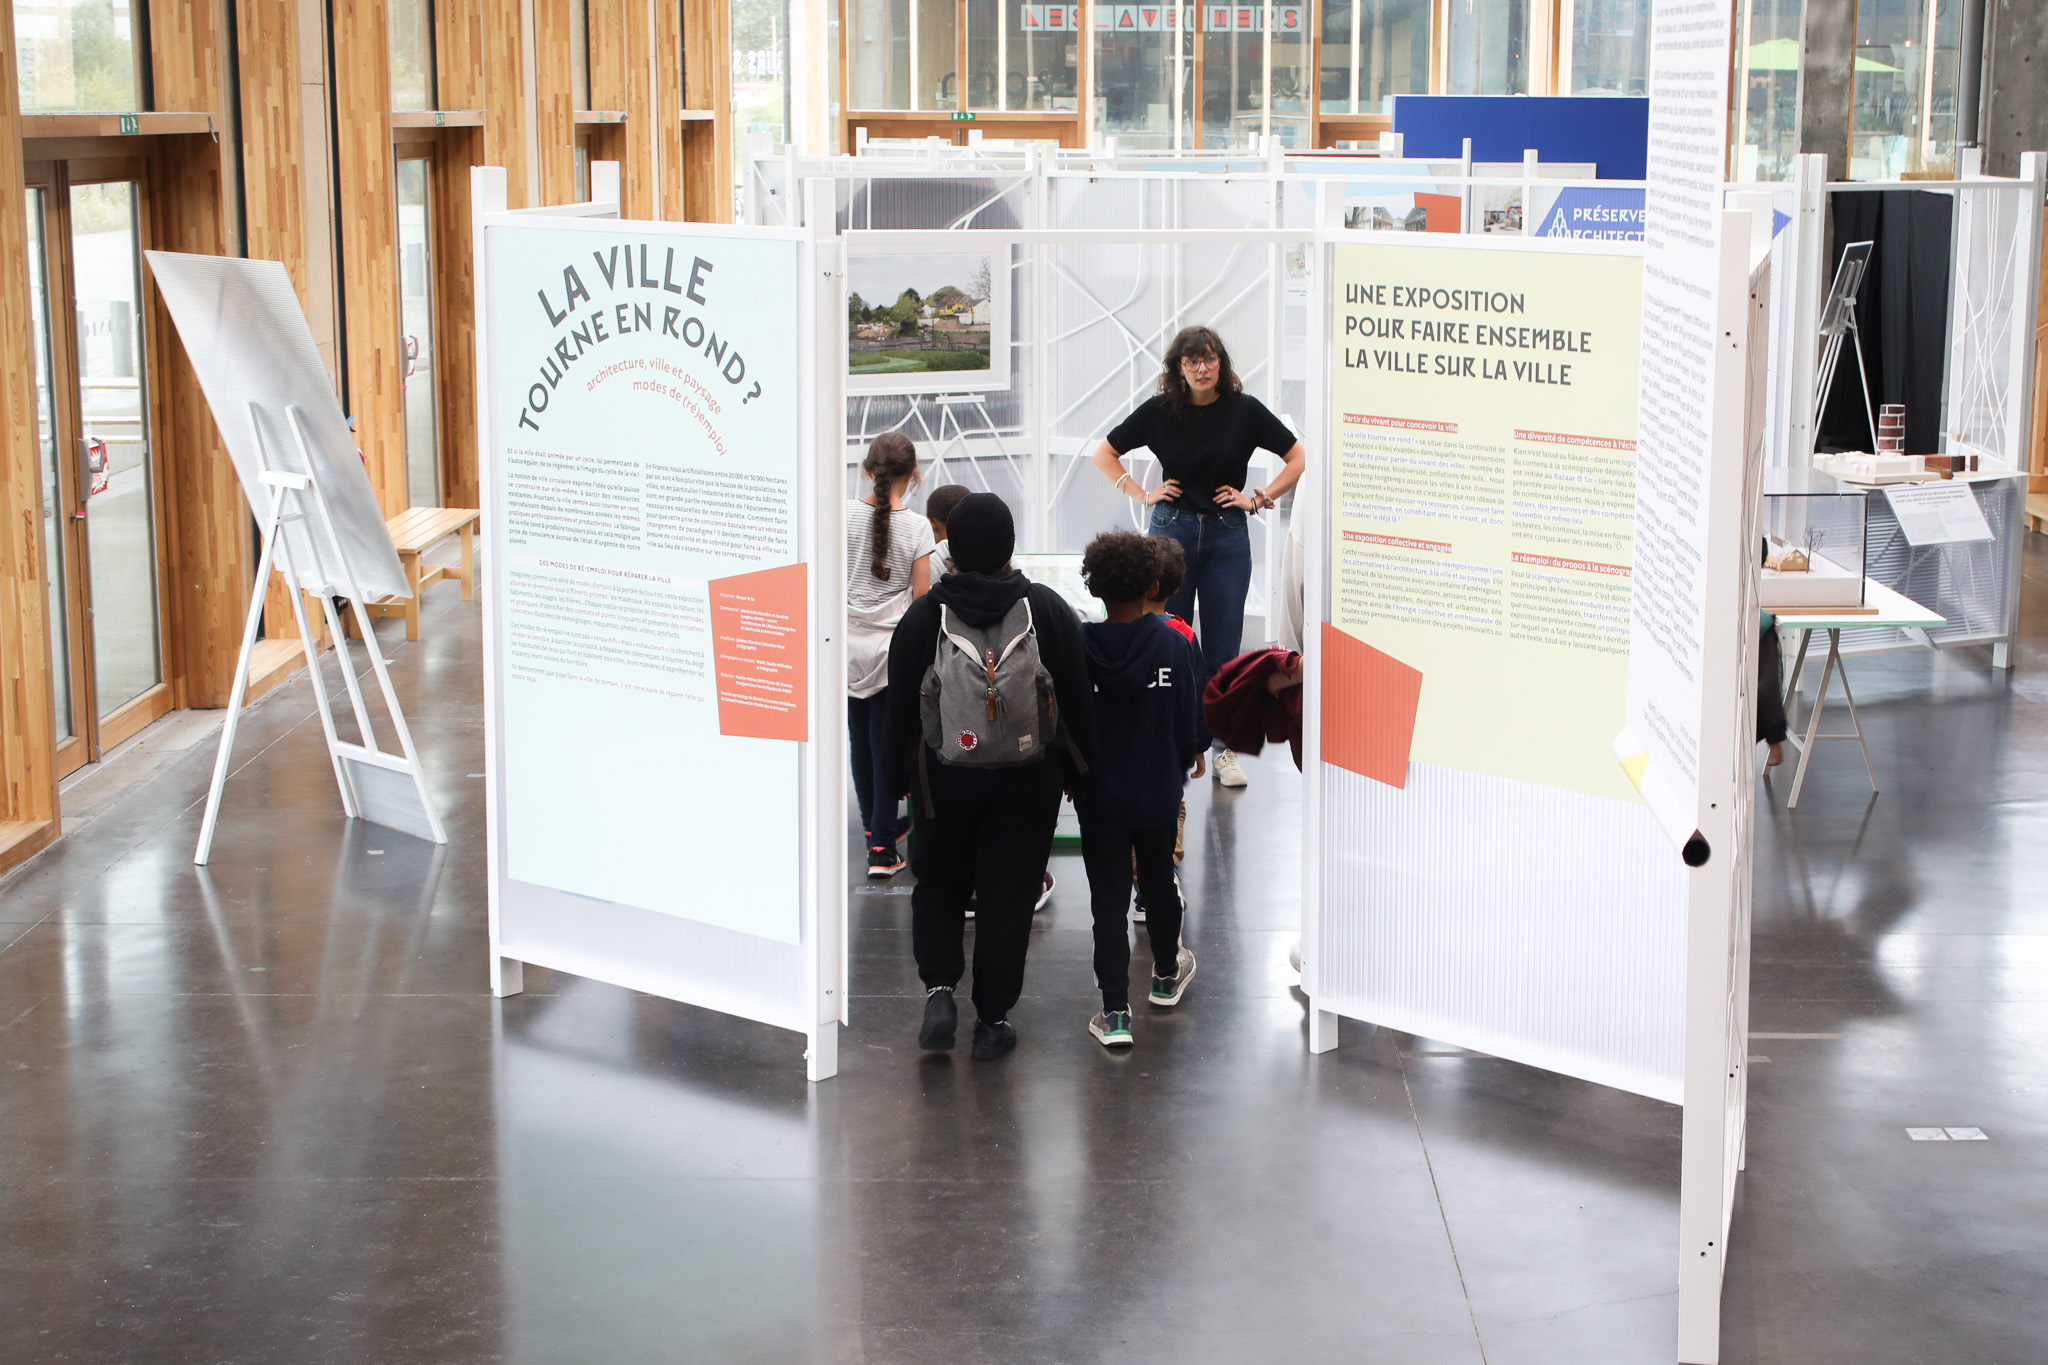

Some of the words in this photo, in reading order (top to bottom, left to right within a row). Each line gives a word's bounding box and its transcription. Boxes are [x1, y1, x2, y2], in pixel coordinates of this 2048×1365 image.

[1574, 204, 1645, 223] PRÉSERVE
[538, 265, 590, 328] LA
[593, 244, 713, 306] VILLE
[1347, 283, 1386, 305] UNE
[1393, 286, 1524, 314] EXPOSITION
[1346, 316, 1404, 339] POUR
[1412, 320, 1468, 344] FAIRE
[1476, 325, 1591, 352] ENSEMBLE
[519, 310, 609, 431] TOURNE
[616, 302, 651, 334] EN
[662, 306, 745, 384] ROND
[743, 381, 761, 404] ?
[1346, 348, 1368, 368] LA
[1374, 351, 1427, 373] VILLE
[1435, 355, 1476, 377] SUR
[1483, 359, 1507, 380] LA
[1513, 361, 1571, 385] VILLE
[586, 358, 647, 391] architecture,
[649, 357, 669, 373] ville
[672, 366, 683, 377] et
[683, 374, 721, 415] paysage
[633, 379, 667, 395] modes
[669, 387, 682, 402] de
[683, 396, 727, 456] (ré)emploi
[1344, 415, 1361, 423] Partir
[1362, 416, 1370, 424] du
[1371, 417, 1390, 426] vivant
[1406, 420, 1437, 430] concevoir
[1438, 423, 1444, 431] la
[1445, 424, 1458, 432] ville
[1514, 432, 1526, 440] Une
[1528, 433, 1556, 442] diversité
[1567, 437, 1611, 449] compétences
[515, 472, 530, 480] notion
[538, 474, 548, 482] ville
[549, 476, 571, 485] circulaire
[572, 478, 592, 489] exprime
[593, 481, 606, 489] l'idée
[607, 482, 623, 493] qu'elle
[624, 484, 640, 495] puisse
[1360, 472, 1374, 482] trop
[1374, 473, 1405, 485] longtemps
[1406, 477, 1428, 486] associé
[1429, 479, 1438, 487] les
[1439, 480, 1454, 489] villes
[1473, 484, 1505, 494] dimension
[1429, 469, 1459, 481] pollutions
[1460, 472, 1470, 480] des
[1489, 476, 1505, 484] Nous
[515, 482, 540, 491] construire
[585, 490, 600, 500] partir
[602, 491, 610, 499] des
[612, 495, 640, 503] ressources
[646, 492, 657, 500] sont
[666, 494, 683, 504] grande
[684, 496, 700, 506] partie
[701, 498, 735, 510] responsables
[744, 503, 777, 515] l'épuisement
[778, 507, 788, 515] des
[508, 499, 539, 511] reproduisant
[540, 503, 556, 513] depuis
[564, 506, 594, 516] nombreuses
[595, 510, 613, 518] années
[622, 513, 640, 522] mêmes
[509, 508, 530, 519] pratiques
[531, 511, 572, 524] anthropocentrées
[620, 522, 641, 533] fabrique
[646, 503, 674, 511] ressources
[675, 504, 700, 514] naturelles
[710, 508, 724, 517] notre
[747, 513, 774, 523] Comment
[774, 516, 788, 525] faire
[1512, 510, 1543, 520] rassemble
[1552, 514, 1571, 523] même
[1343, 532, 1354, 540] Une
[1355, 533, 1386, 546] exposition
[1388, 537, 1417, 548] collective
[1426, 542, 1453, 554] engagée
[1512, 531, 1522, 539] ont
[1524, 532, 1533, 540] été
[1534, 536, 1555, 545] conçus
[1572, 538, 1582, 546] des
[1584, 540, 1613, 550] résidents
[1343, 548, 1357, 557] Cette
[1358, 550, 1380, 560] nouvelle
[1381, 553, 1410, 565] exposition
[1411, 557, 1435, 568] présente
[1442, 560, 1466, 572] réemploi
[1489, 566, 1504, 575] l'une
[1512, 554, 1518, 562] Le
[1520, 555, 1549, 568] réemploi
[1562, 563, 1586, 572] propos
[1592, 564, 1598, 572] la
[550, 562, 568, 570] MODES
[578, 564, 607, 575] RÉ-EMPLOI
[624, 570, 648, 580] RÉPARER
[657, 576, 672, 584] VILLE
[1416, 597, 1445, 609] designers
[1491, 607, 1503, 615] Elle
